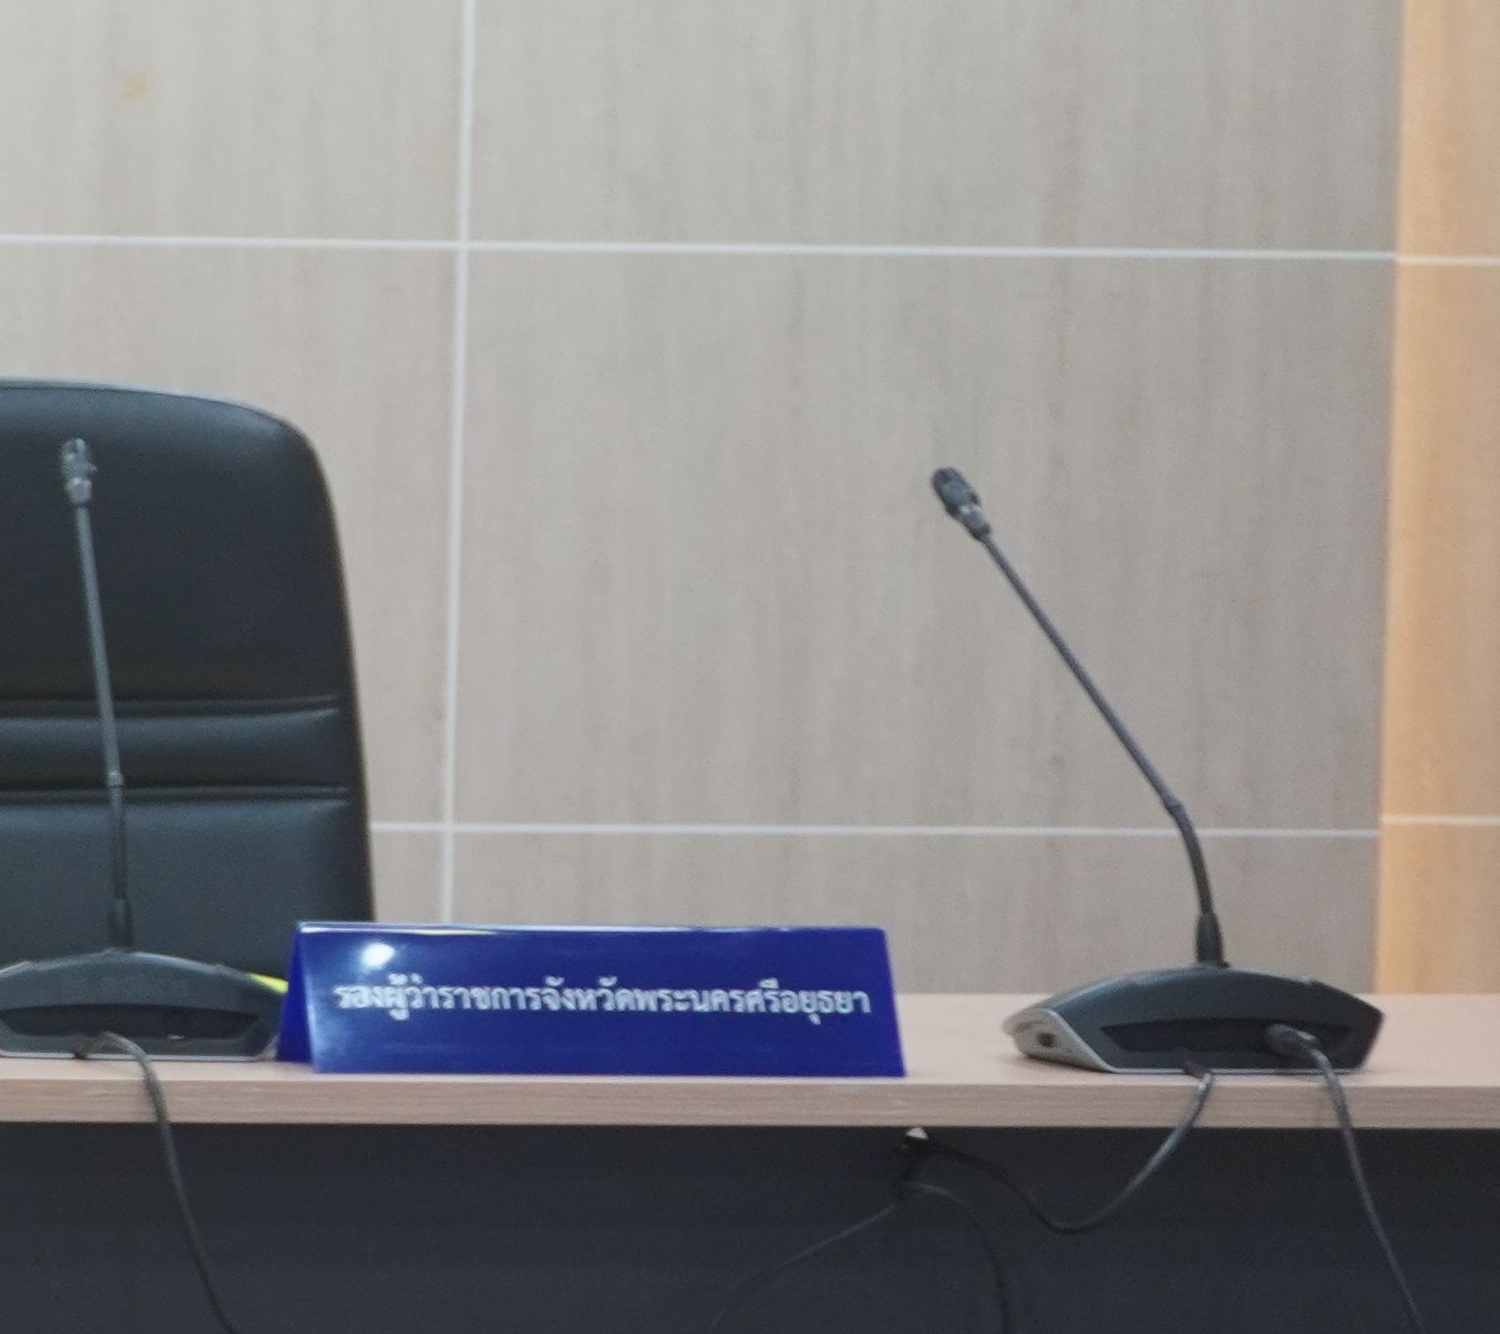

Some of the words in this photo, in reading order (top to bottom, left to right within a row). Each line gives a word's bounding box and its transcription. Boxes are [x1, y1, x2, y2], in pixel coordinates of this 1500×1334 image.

[333, 972, 871, 1025] รองผู้ว่าราชการจังหวัดพระนครศรีอยุธยา
